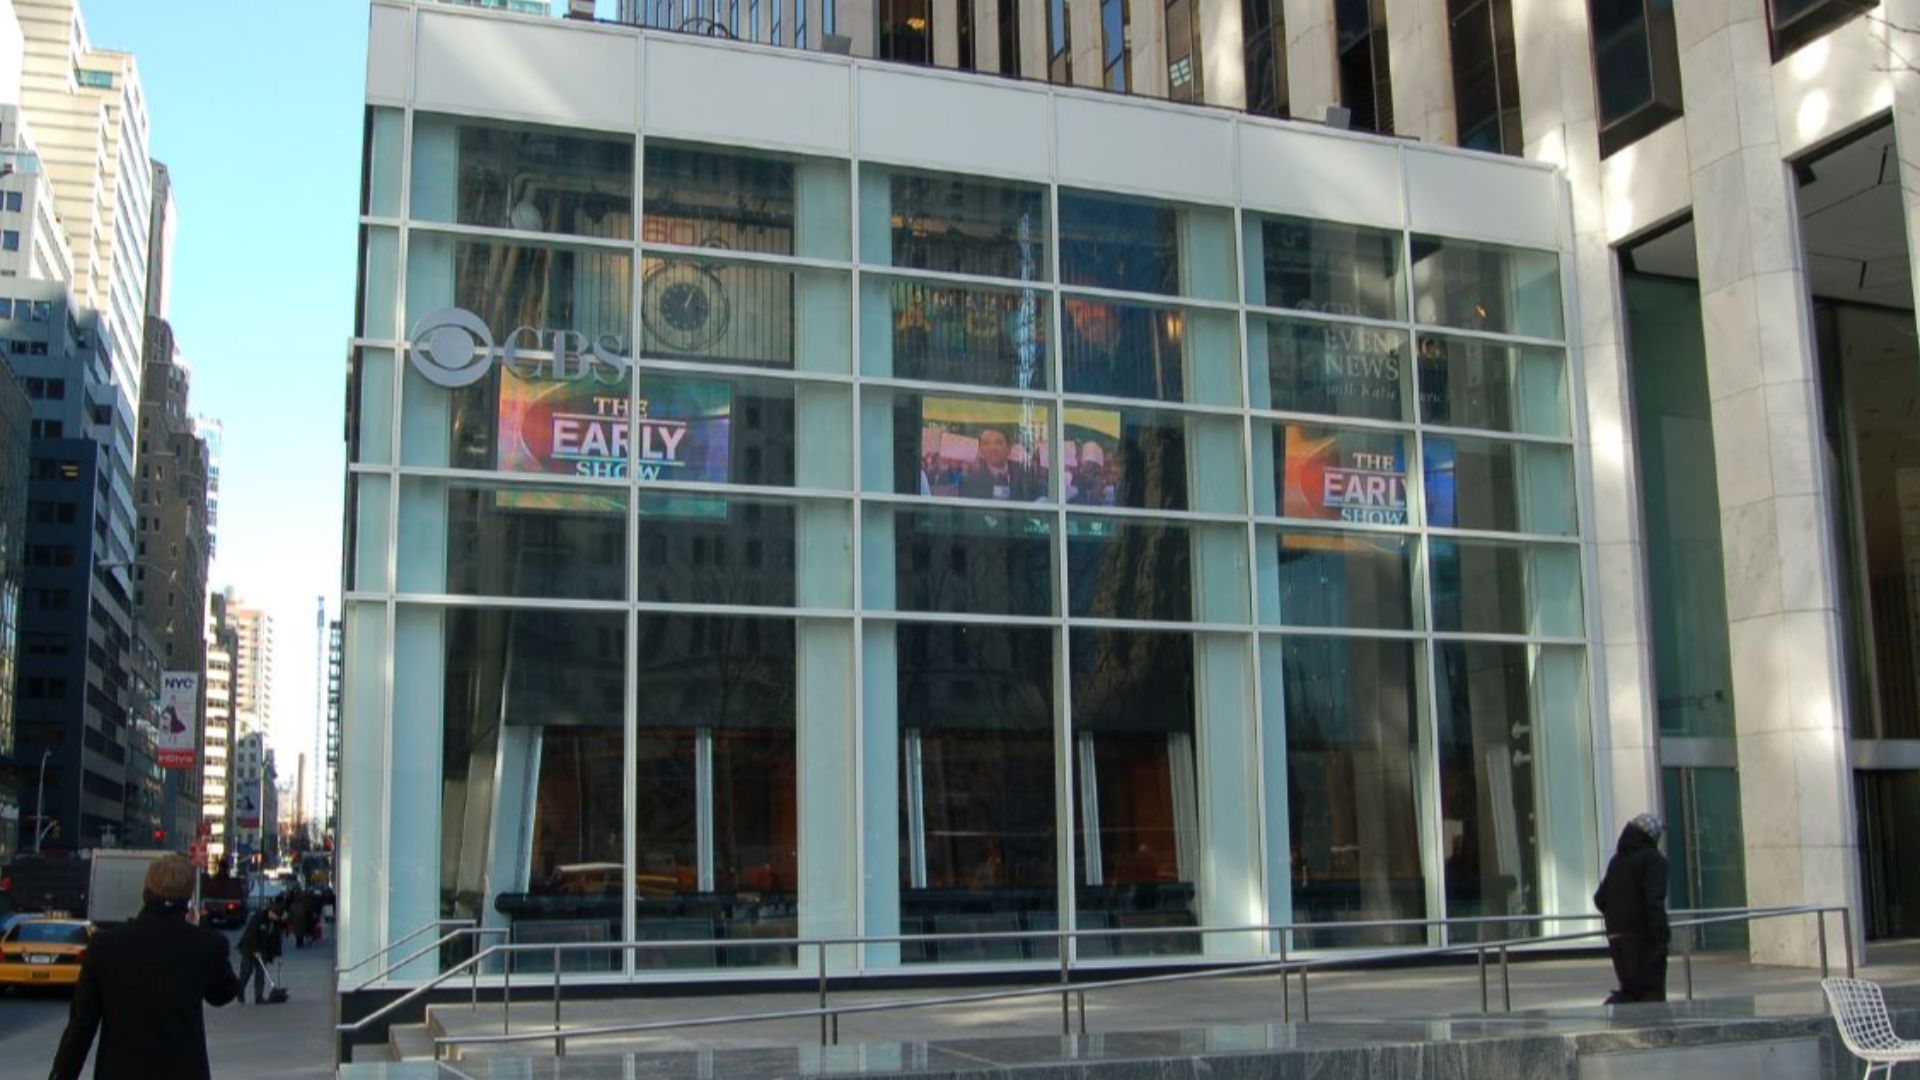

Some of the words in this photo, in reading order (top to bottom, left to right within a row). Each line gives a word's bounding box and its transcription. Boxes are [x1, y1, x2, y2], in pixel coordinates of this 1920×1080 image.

[503, 325, 629, 385] CBS
[1325, 353, 1399, 380] NEWS
[593, 396, 649, 418] THE
[553, 419, 686, 460] EARLY
[576, 460, 660, 480] SHOW
[1352, 452, 1394, 472] THE
[1323, 471, 1408, 508] EARL
[1341, 508, 1404, 525] SHOW
[165, 677, 192, 690] NYC
